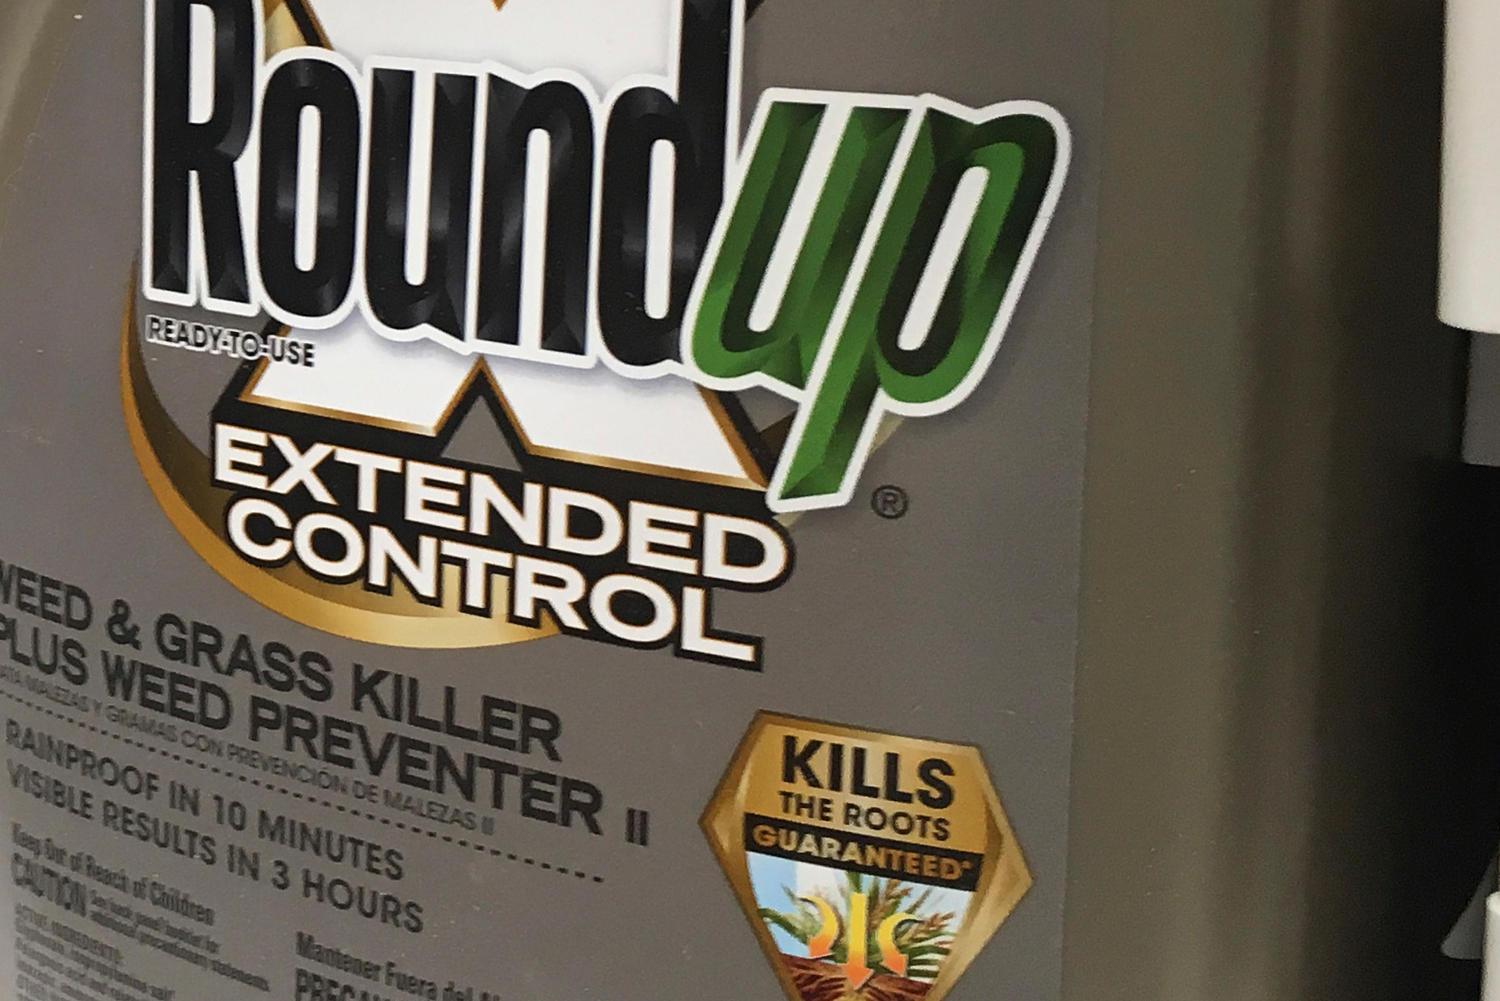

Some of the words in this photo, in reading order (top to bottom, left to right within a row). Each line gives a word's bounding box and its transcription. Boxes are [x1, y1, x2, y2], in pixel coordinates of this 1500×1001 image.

[146, 314, 315, 368] READY-TO-USE
[214, 425, 791, 588] EXTENDED
[225, 498, 762, 670] CONTROL
[100, 649, 233, 731] WEED
[248, 696, 605, 836] PREVENTER
[625, 807, 650, 847] II
[107, 599, 142, 651] &
[154, 613, 334, 702] GRASS
[350, 663, 563, 763] KILLER
[5, 717, 160, 801] RAINPROOF
[168, 781, 200, 817] IN
[211, 795, 248, 832] 10
[257, 809, 406, 882] MINUTES
[5, 756, 95, 822] VISIBLE
[102, 799, 218, 866] RESULTS
[226, 843, 261, 882] IN
[269, 859, 292, 891] 3
[301, 868, 425, 934] HOURS
[180, 729, 224, 759] CON
[226, 743, 348, 796] PREVENCIÓN
[352, 778, 380, 805] DE
[382, 786, 478, 835] MALEZAS
[776, 790, 833, 824] THE
[842, 803, 952, 842] ROOTS
[780, 734, 956, 810] KILLS
[296, 930, 382, 983] Mantener
[384, 960, 438, 1000] Fuera
